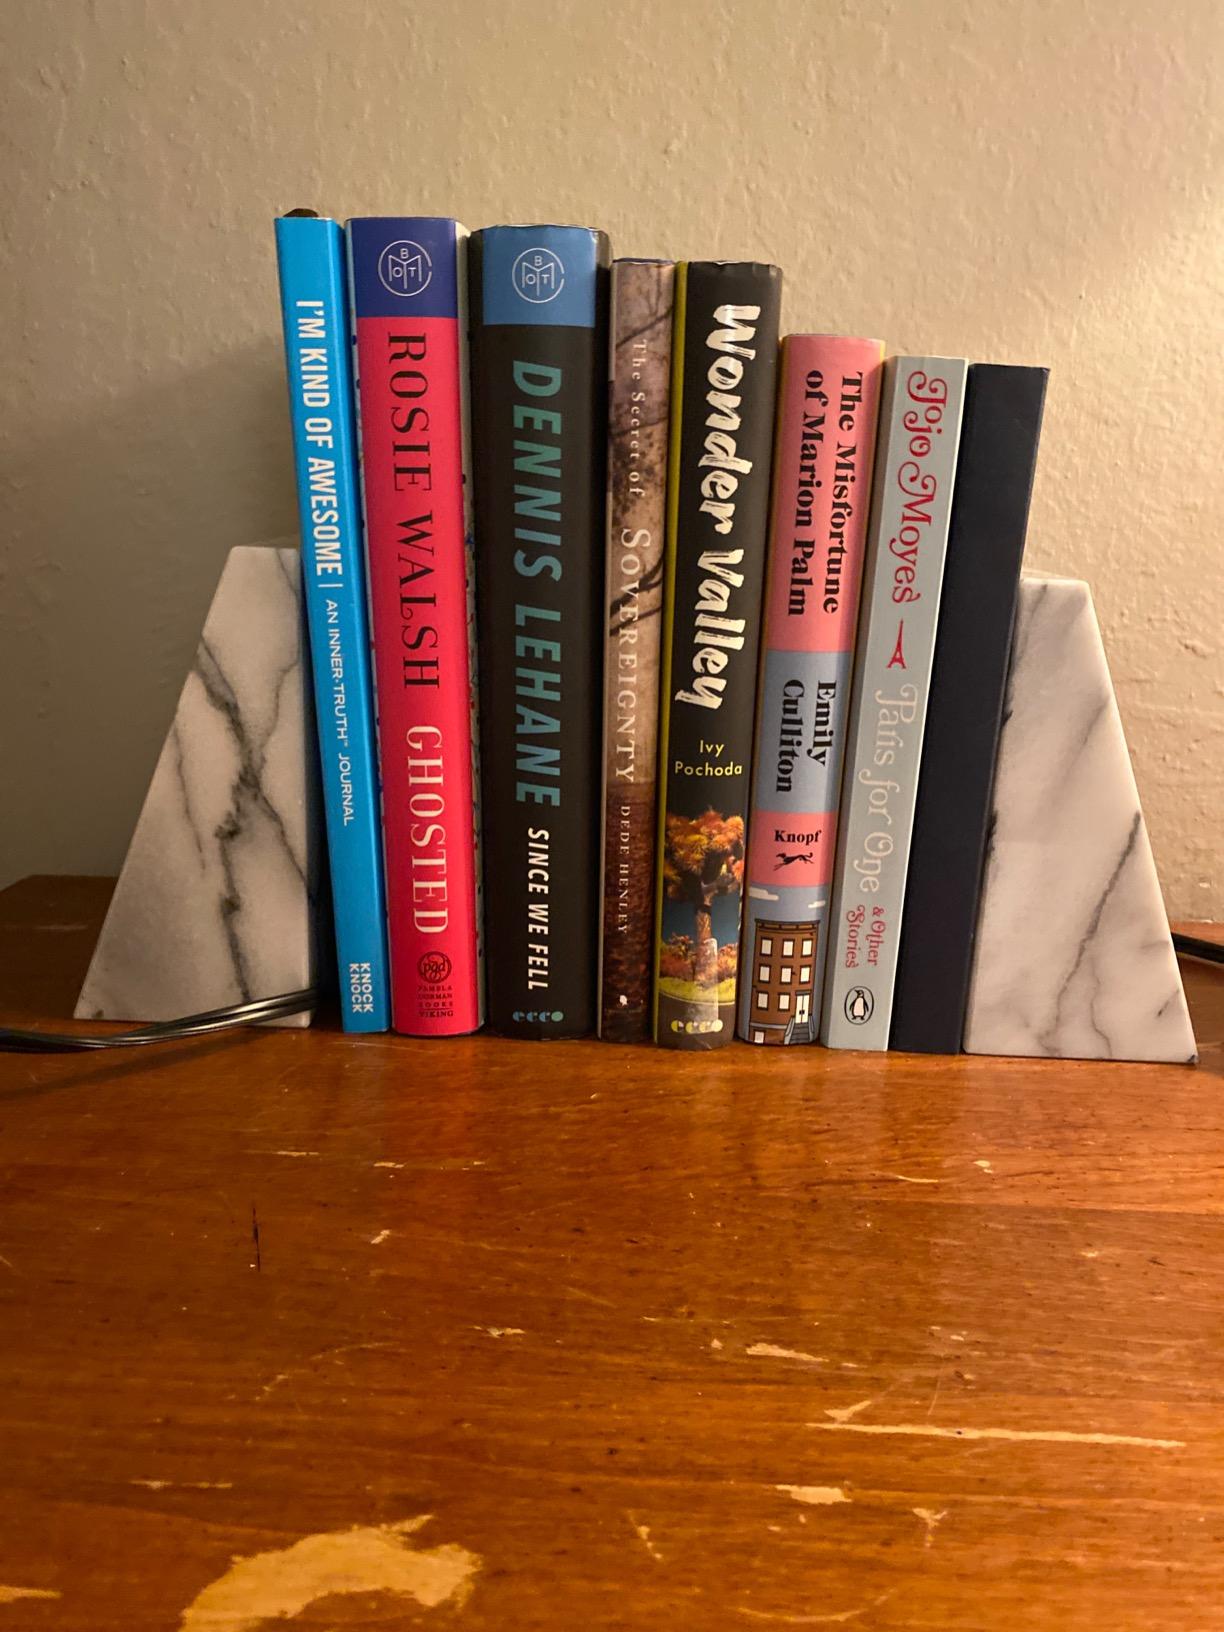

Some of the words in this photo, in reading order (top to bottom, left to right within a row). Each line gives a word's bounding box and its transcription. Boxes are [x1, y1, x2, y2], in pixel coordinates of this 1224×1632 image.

[300, 348, 331, 407] KIND
[632, 339, 646, 380] The
[804, 369, 829, 407] of
[305, 417, 333, 448] OF
[388, 332, 431, 491] ROSIE
[630, 392, 645, 462] Secret
[698, 305, 761, 535] Wonder
[838, 371, 863, 431] The
[903, 370, 948, 457] Jojo
[512, 360, 562, 582] DENNIS
[629, 472, 645, 497] of
[795, 411, 825, 529] Marion
[307, 456, 343, 577] AWESOME
[822, 443, 857, 614] Misfortune
[889, 461, 937, 604] Moyes
[396, 510, 440, 688] WALSH
[788, 538, 816, 616] Palm
[326, 600, 338, 623] AN
[675, 548, 746, 711] Valley
[615, 528, 650, 783] SOVEREIGNTY
[515, 604, 561, 806] LEHANE
[775, 679, 805, 793] Culliton
[807, 680, 837, 767] Emily
[873, 683, 917, 765] Paris
[675, 761, 743, 777] Pochoda
[700, 741, 725, 758] Ivy
[338, 753, 354, 826] JOURNAL
[858, 768, 900, 825] for
[406, 726, 449, 933] GHOSTED
[528, 827, 549, 895] SINCE
[620, 806, 630, 854] DEDE
[774, 829, 822, 844] Knopf
[853, 831, 893, 892] One
[528, 903, 549, 936] WE
[618, 864, 629, 933] HENLEY
[872, 906, 884, 917] &
[528, 943, 549, 990] FELL
[845, 904, 866, 968] Stories
[865, 920, 886, 966] Other
[350, 963, 362, 1013] KNOCK
[361, 963, 374, 1013] KNOCK
